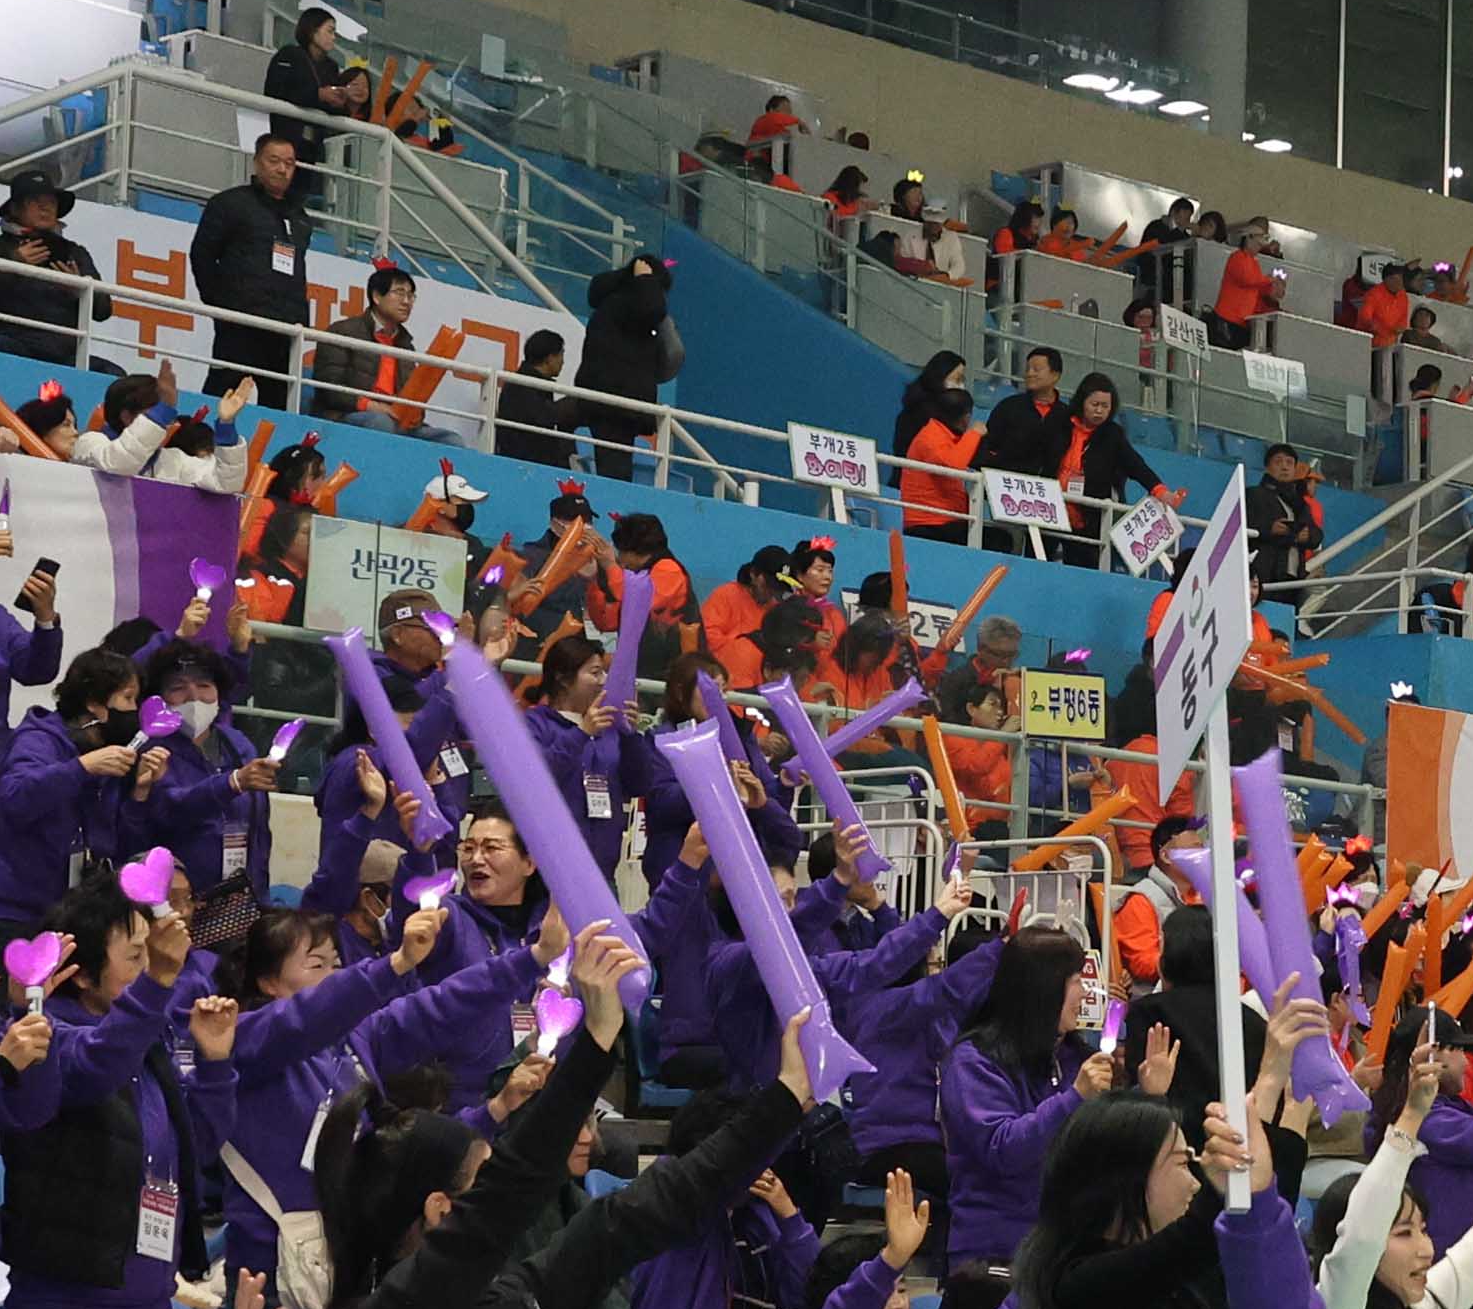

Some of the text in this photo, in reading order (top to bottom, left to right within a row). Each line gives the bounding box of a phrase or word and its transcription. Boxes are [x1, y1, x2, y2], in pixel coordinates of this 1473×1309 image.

[1167, 315, 1205, 351] 갈산1동
[809, 433, 857, 459] 부개2동
[1002, 476, 1047, 498] 부개2동
[1123, 501, 1158, 537] 부개2동
[350, 548, 439, 591] 산곡2동
[1181, 609, 1219, 731] 동구
[1048, 686, 1100, 725] 부평6동
